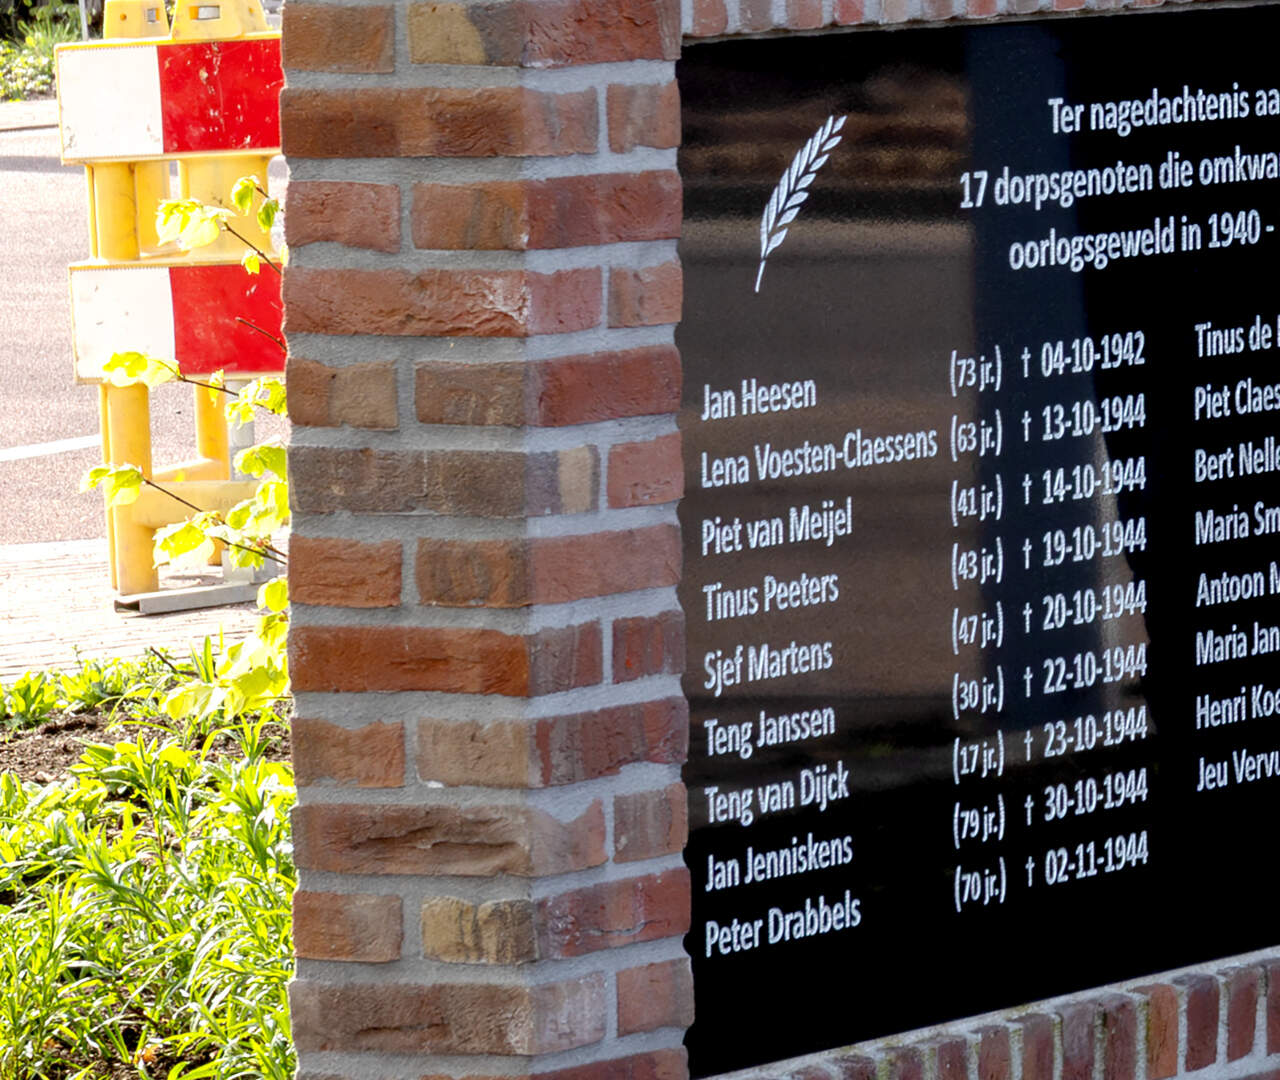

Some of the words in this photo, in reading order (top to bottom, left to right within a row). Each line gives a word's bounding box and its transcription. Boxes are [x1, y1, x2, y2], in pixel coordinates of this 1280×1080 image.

[1047, 97, 1085, 134] Ter
[1090, 81, 1250, 138] nagedachtenis
[959, 170, 989, 209] 17
[993, 160, 1154, 212] dorpsgenoten
[1158, 150, 1194, 190] die
[1008, 215, 1175, 273] oorlogsgeweld
[1180, 214, 1202, 252] in
[1207, 208, 1262, 249] 1940
[1194, 321, 1245, 358] Tinus
[1248, 314, 1273, 352] de
[700, 383, 736, 421] Jan
[741, 378, 817, 416] Heesen
[949, 349, 977, 398] (73
[978, 344, 1003, 393] jr.)
[1040, 330, 1146, 378] 04-10-1942
[1194, 383, 1231, 421] Piet
[701, 451, 750, 489] Lena
[754, 428, 938, 481] Voesten-Claessens
[950, 414, 978, 462] (63
[979, 408, 1003, 457] jr.)
[1041, 392, 1147, 441] 13-10-1944
[1194, 447, 1235, 483] Bert
[702, 516, 743, 557] Piet
[746, 517, 784, 549] van
[789, 496, 853, 547] Meijel
[950, 479, 978, 527] (41
[979, 473, 1004, 522] jr.)
[1042, 455, 1147, 505] 14-10-1944
[1194, 503, 1250, 546] Maria
[702, 581, 760, 622] Tinus
[763, 572, 840, 612] Peeters
[951, 542, 978, 591] (43
[979, 536, 1004, 585] jr.)
[1042, 516, 1148, 567] 19-10-1944
[1195, 571, 1265, 608] Antoon
[703, 644, 744, 698] Sjef
[747, 640, 834, 682] Martens
[951, 607, 979, 656] (47
[980, 600, 1004, 649] jr.)
[1042, 579, 1148, 631] 20-10-1944
[1195, 623, 1248, 666] Maria
[703, 718, 754, 760] Teng
[756, 706, 836, 748] Janssen
[951, 672, 979, 721] (30
[980, 664, 1005, 714] jr.)
[1042, 642, 1148, 695] 22-10-1944
[1195, 685, 1247, 730] Henri
[703, 785, 754, 827] Teng
[757, 780, 795, 814] van
[800, 759, 850, 813] Dijck
[952, 736, 980, 785] (17
[980, 729, 1005, 779] jr.)
[1043, 704, 1149, 758] 23-10-1944
[1196, 756, 1229, 792] Jeu
[704, 853, 740, 893] Jan
[743, 831, 854, 885] Jenniskens
[952, 801, 980, 850] (79
[981, 793, 1006, 843] jr.)
[1043, 767, 1149, 822] 30-10-1944
[705, 917, 764, 958] Peter
[767, 889, 862, 945] Drabbels
[954, 864, 982, 913] (70
[983, 856, 1007, 906] jr.)
[1044, 829, 1149, 886] 02-11-1944
